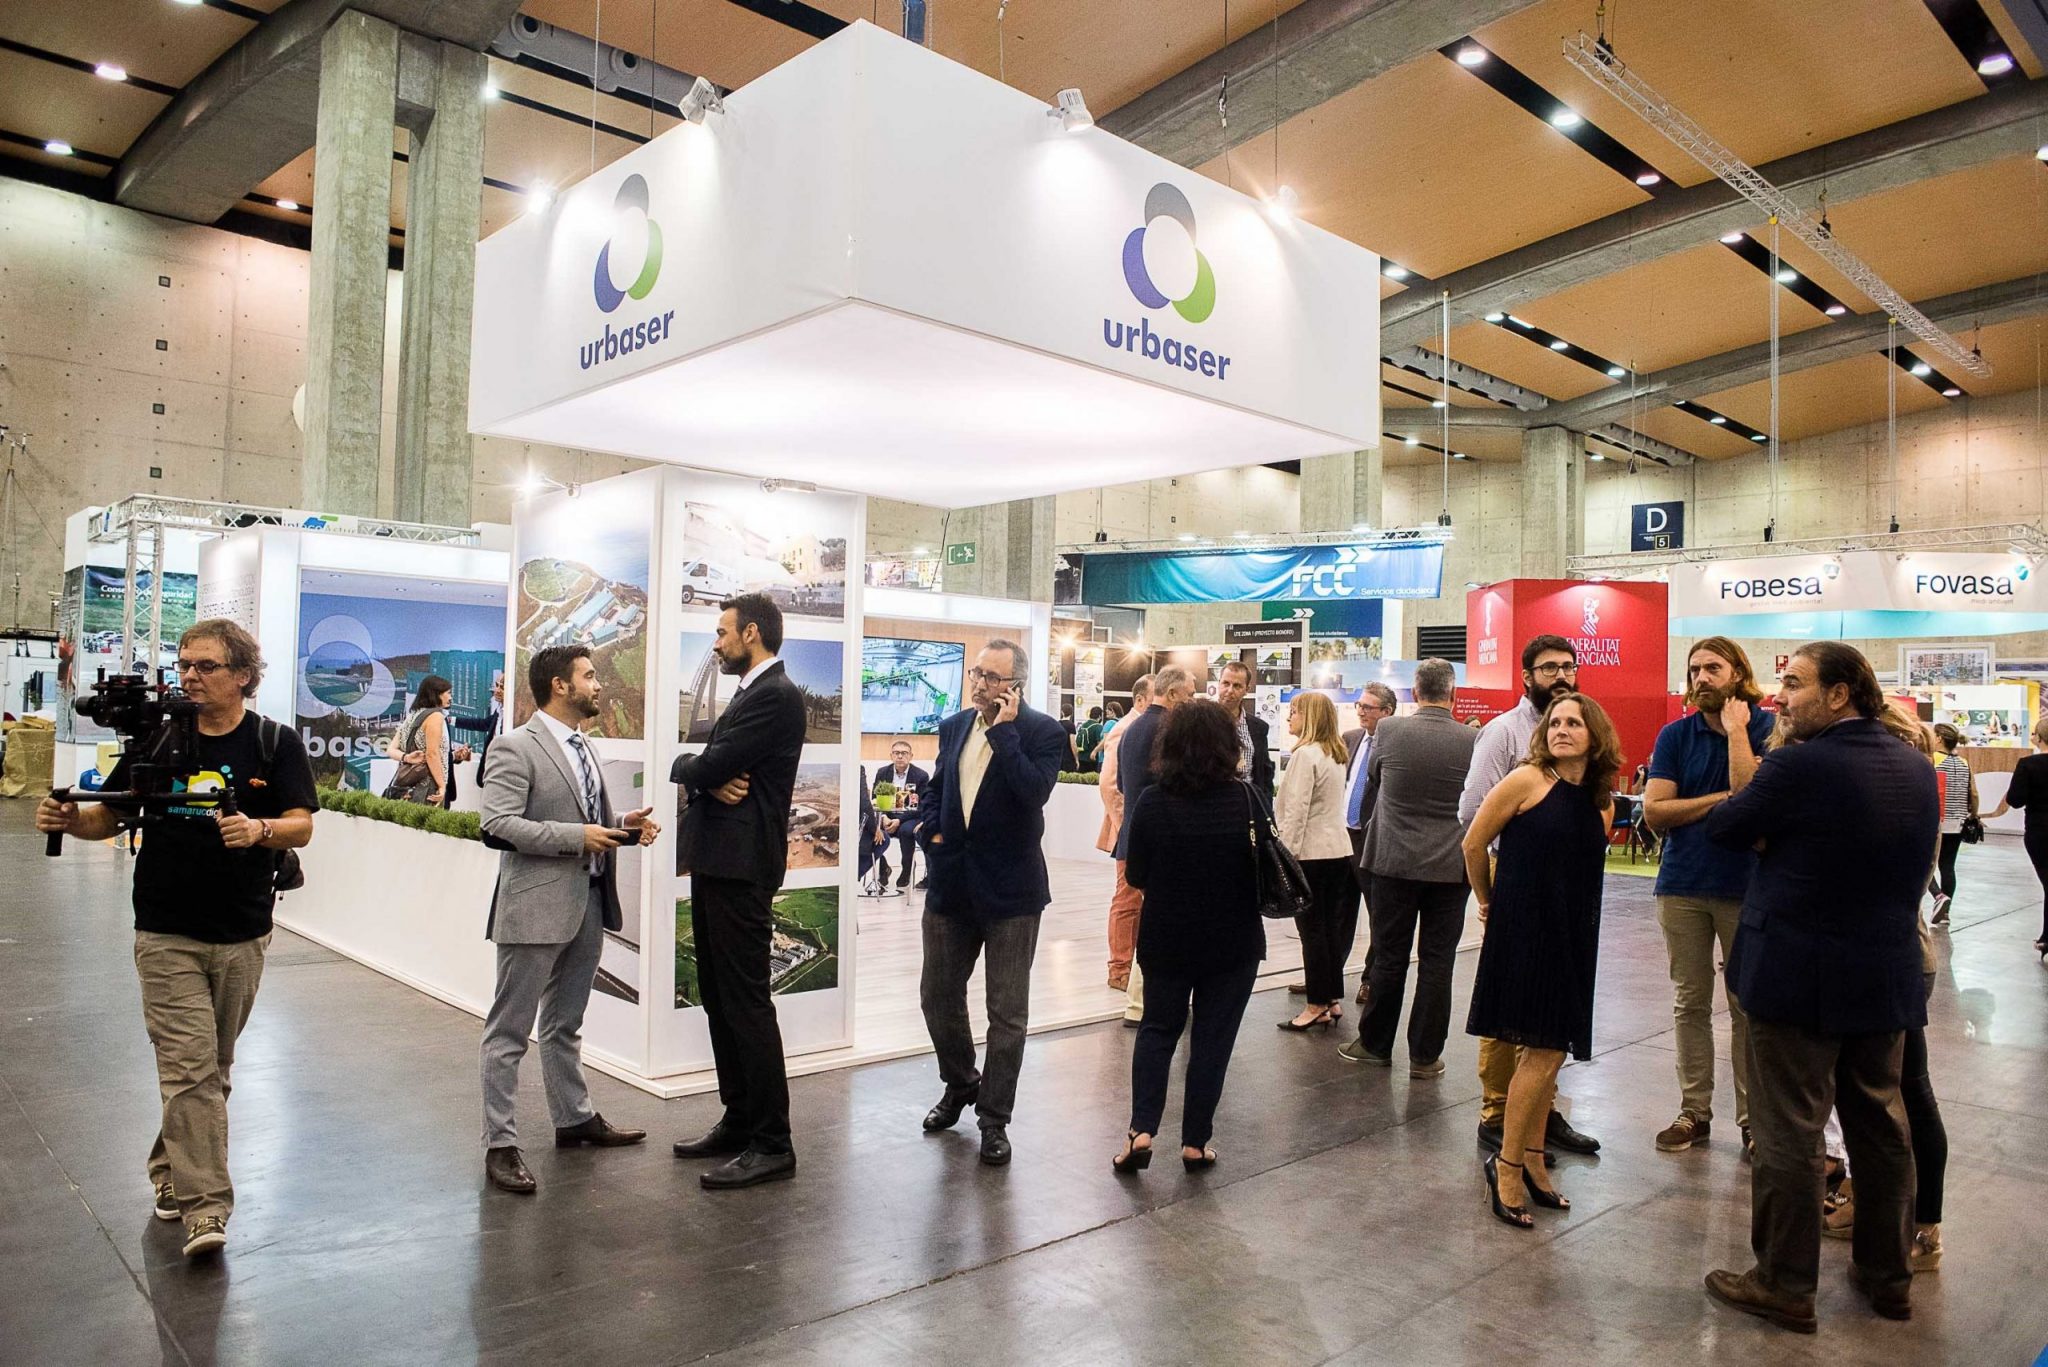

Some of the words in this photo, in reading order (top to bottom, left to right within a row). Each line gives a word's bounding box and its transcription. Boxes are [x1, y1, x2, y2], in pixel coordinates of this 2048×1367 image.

[581, 310, 674, 370] urbaser
[1103, 317, 1231, 380] urbaser
[1646, 507, 1668, 533] D
[1658, 537, 1666, 547] 5
[1292, 564, 1357, 597] FCC
[1576, 652, 1621, 666] ENCIANA
[302, 726, 392, 758] base
